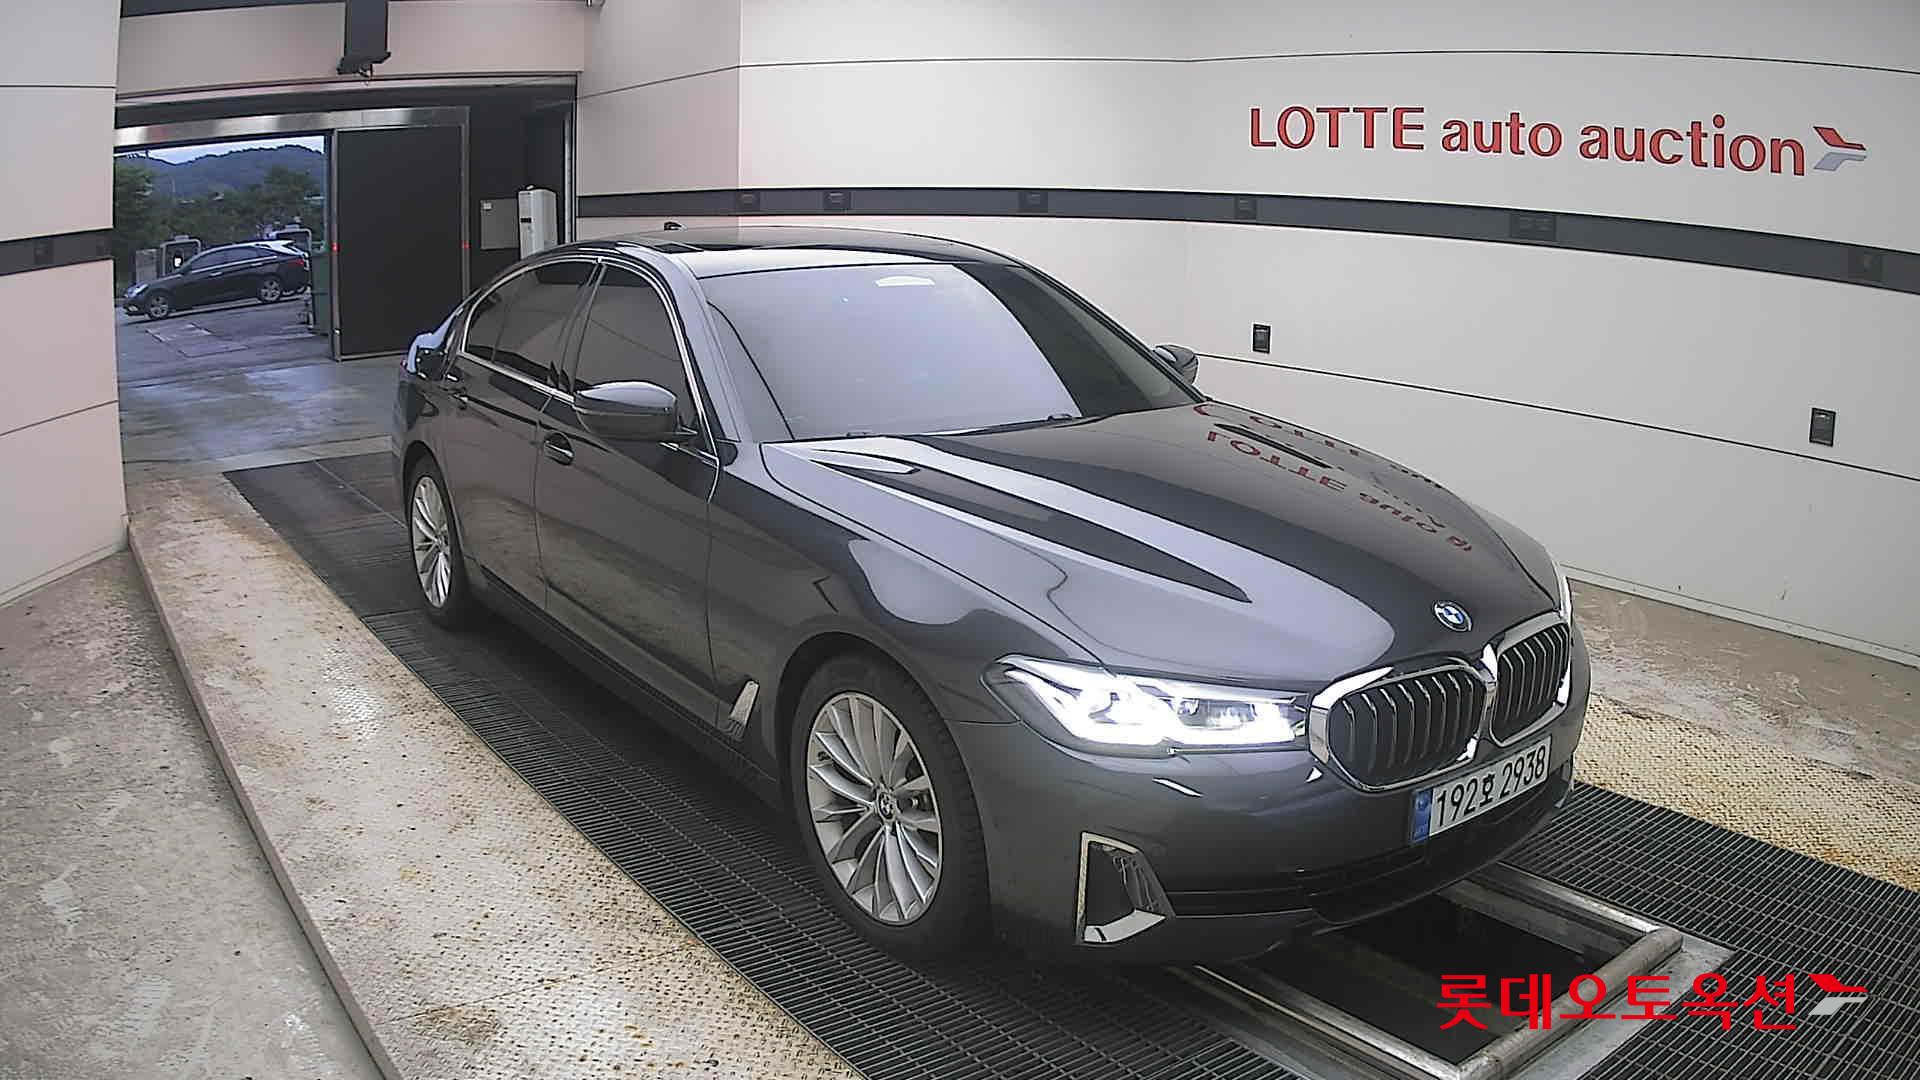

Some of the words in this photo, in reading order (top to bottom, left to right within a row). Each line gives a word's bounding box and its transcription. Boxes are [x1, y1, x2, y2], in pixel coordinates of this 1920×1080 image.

[1250, 106, 1425, 150] LOTTE
[1441, 112, 1562, 157] auto
[1580, 114, 1806, 177] auction
[1437, 773, 1496, 827] 192호
[1500, 745, 1547, 799] 2938
